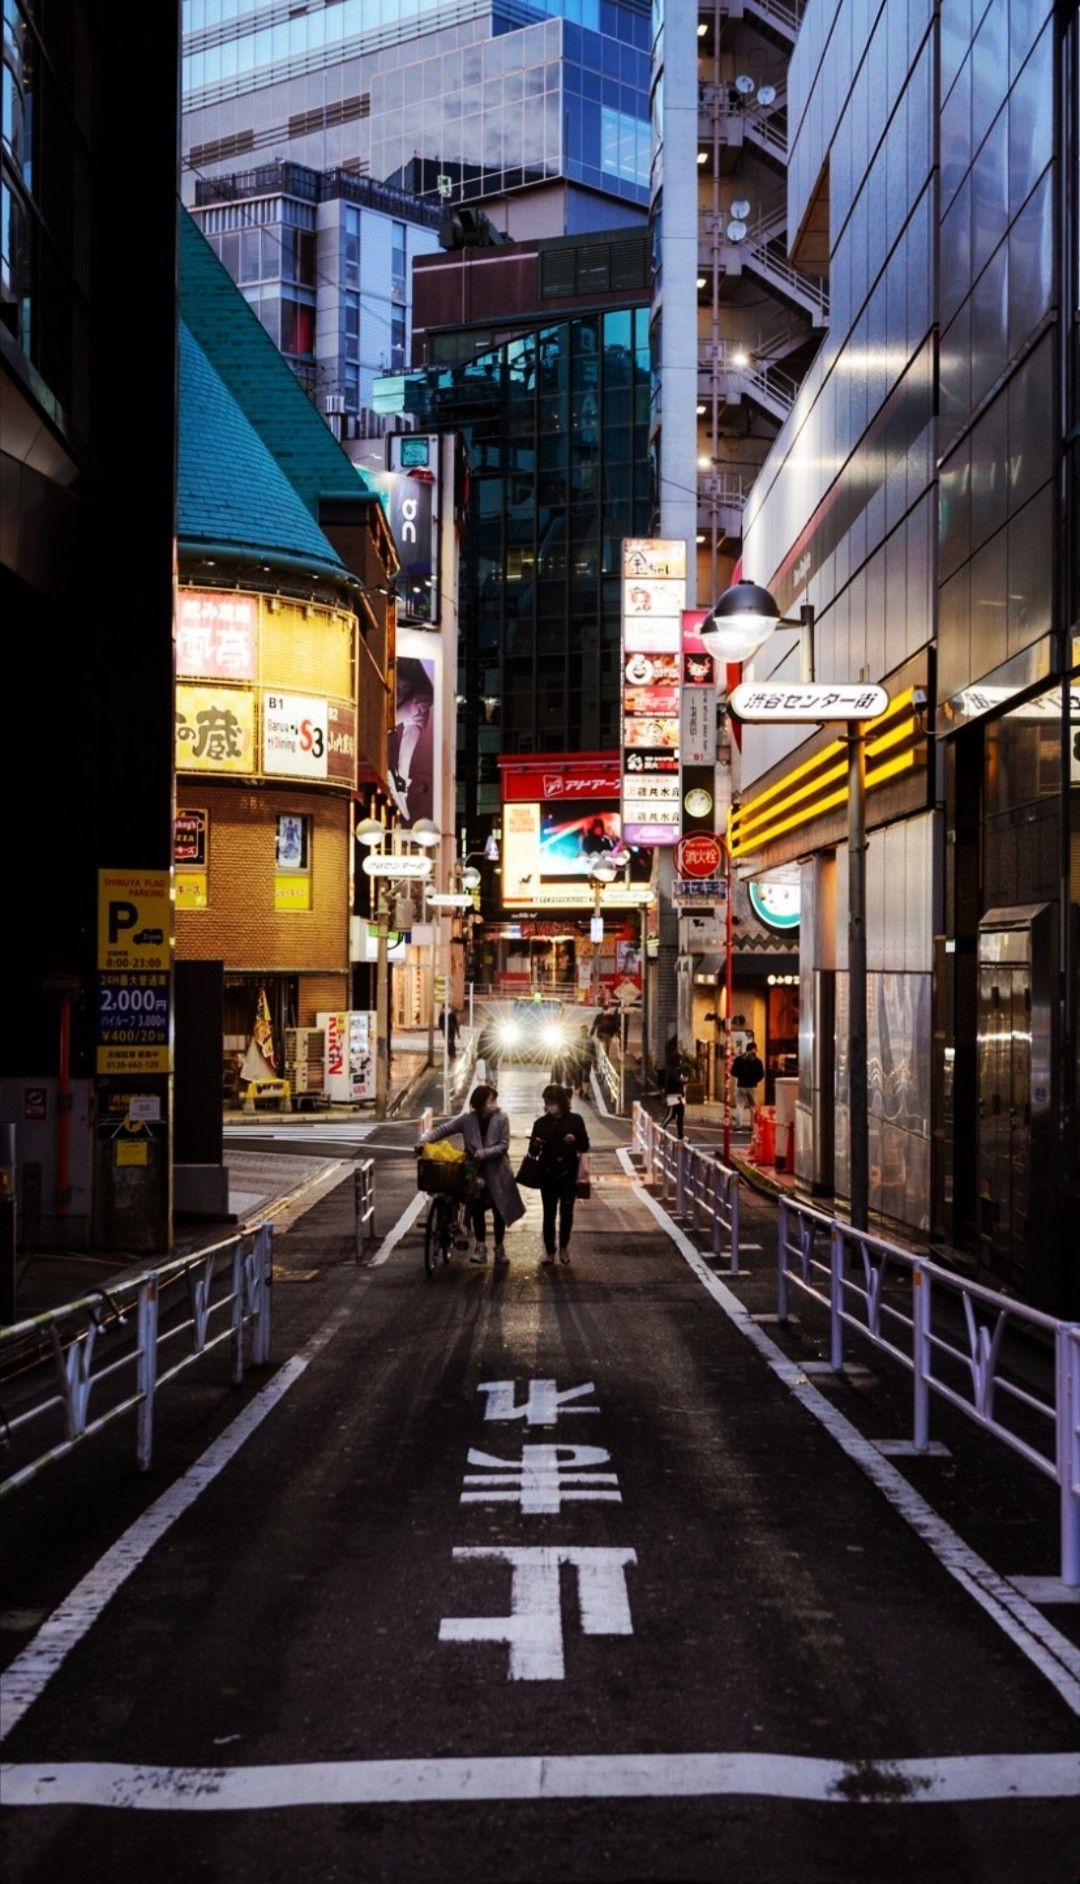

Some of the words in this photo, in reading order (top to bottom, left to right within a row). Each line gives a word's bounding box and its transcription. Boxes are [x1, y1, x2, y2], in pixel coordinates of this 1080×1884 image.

[269, 697, 283, 709] B1
[744, 693, 878, 709] 渋谷センター街
[176, 705, 242, 760] の蔵
[108, 901, 138, 944] P
[101, 990, 167, 1011] 2,000円
